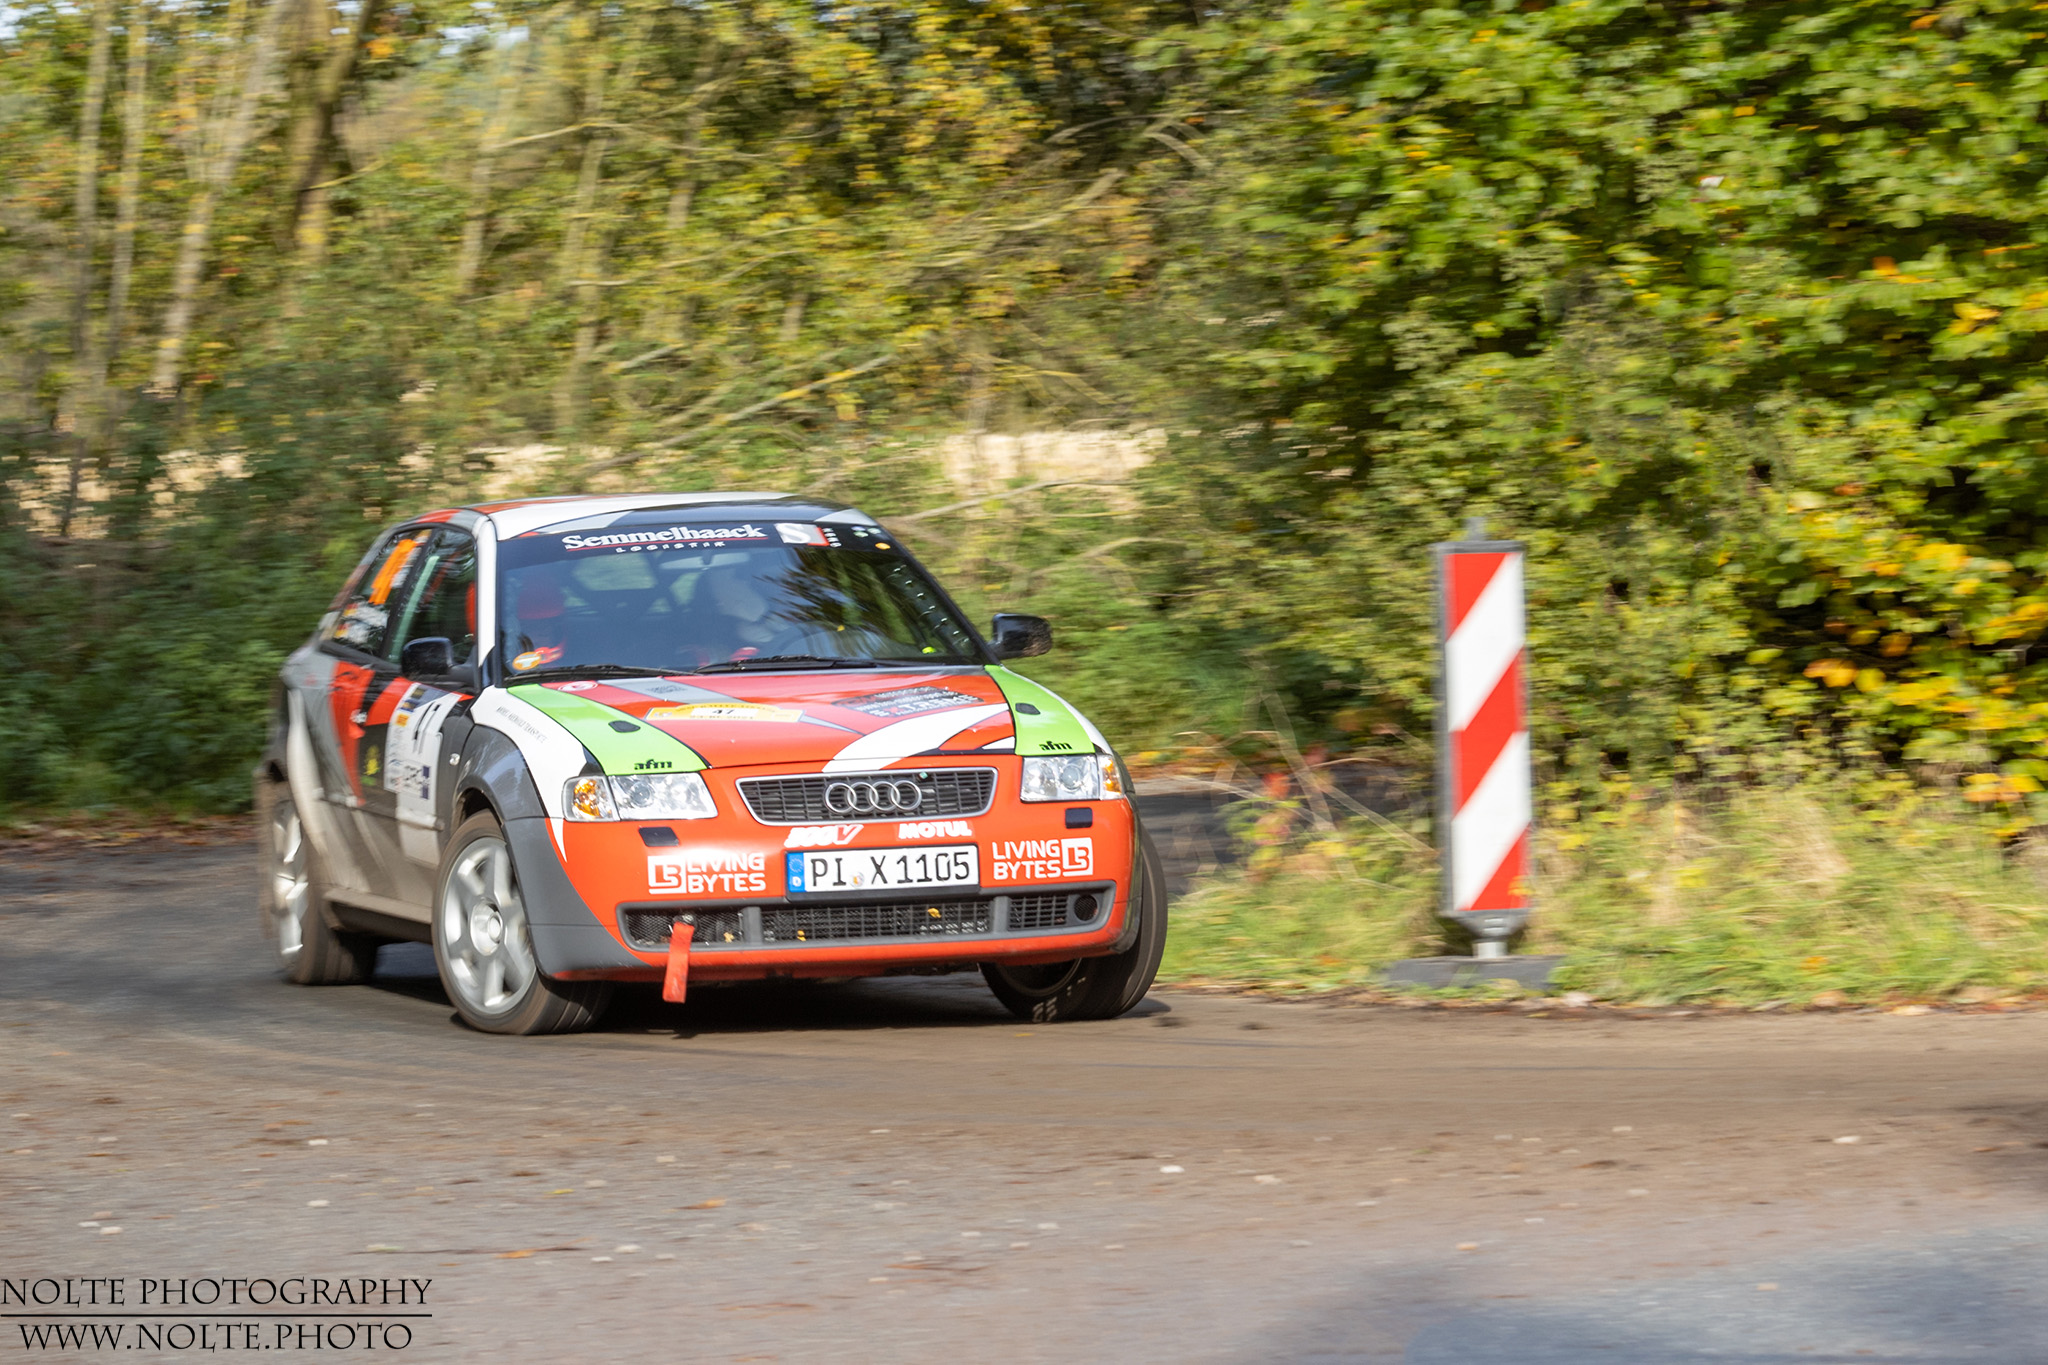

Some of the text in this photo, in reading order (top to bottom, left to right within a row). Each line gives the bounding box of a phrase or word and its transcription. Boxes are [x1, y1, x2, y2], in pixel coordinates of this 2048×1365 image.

[562, 525, 766, 549] Semmelhaack
[616, 541, 727, 553] LOGISTIK
[1040, 740, 1073, 751] afm
[634, 759, 673, 770] afm
[898, 821, 972, 840] MOTUL
[992, 839, 1060, 860] LIVING
[687, 853, 765, 872] LIVING
[810, 851, 970, 887] PI X 1105
[993, 860, 1061, 880] BYTES
[687, 873, 766, 894] BYTES
